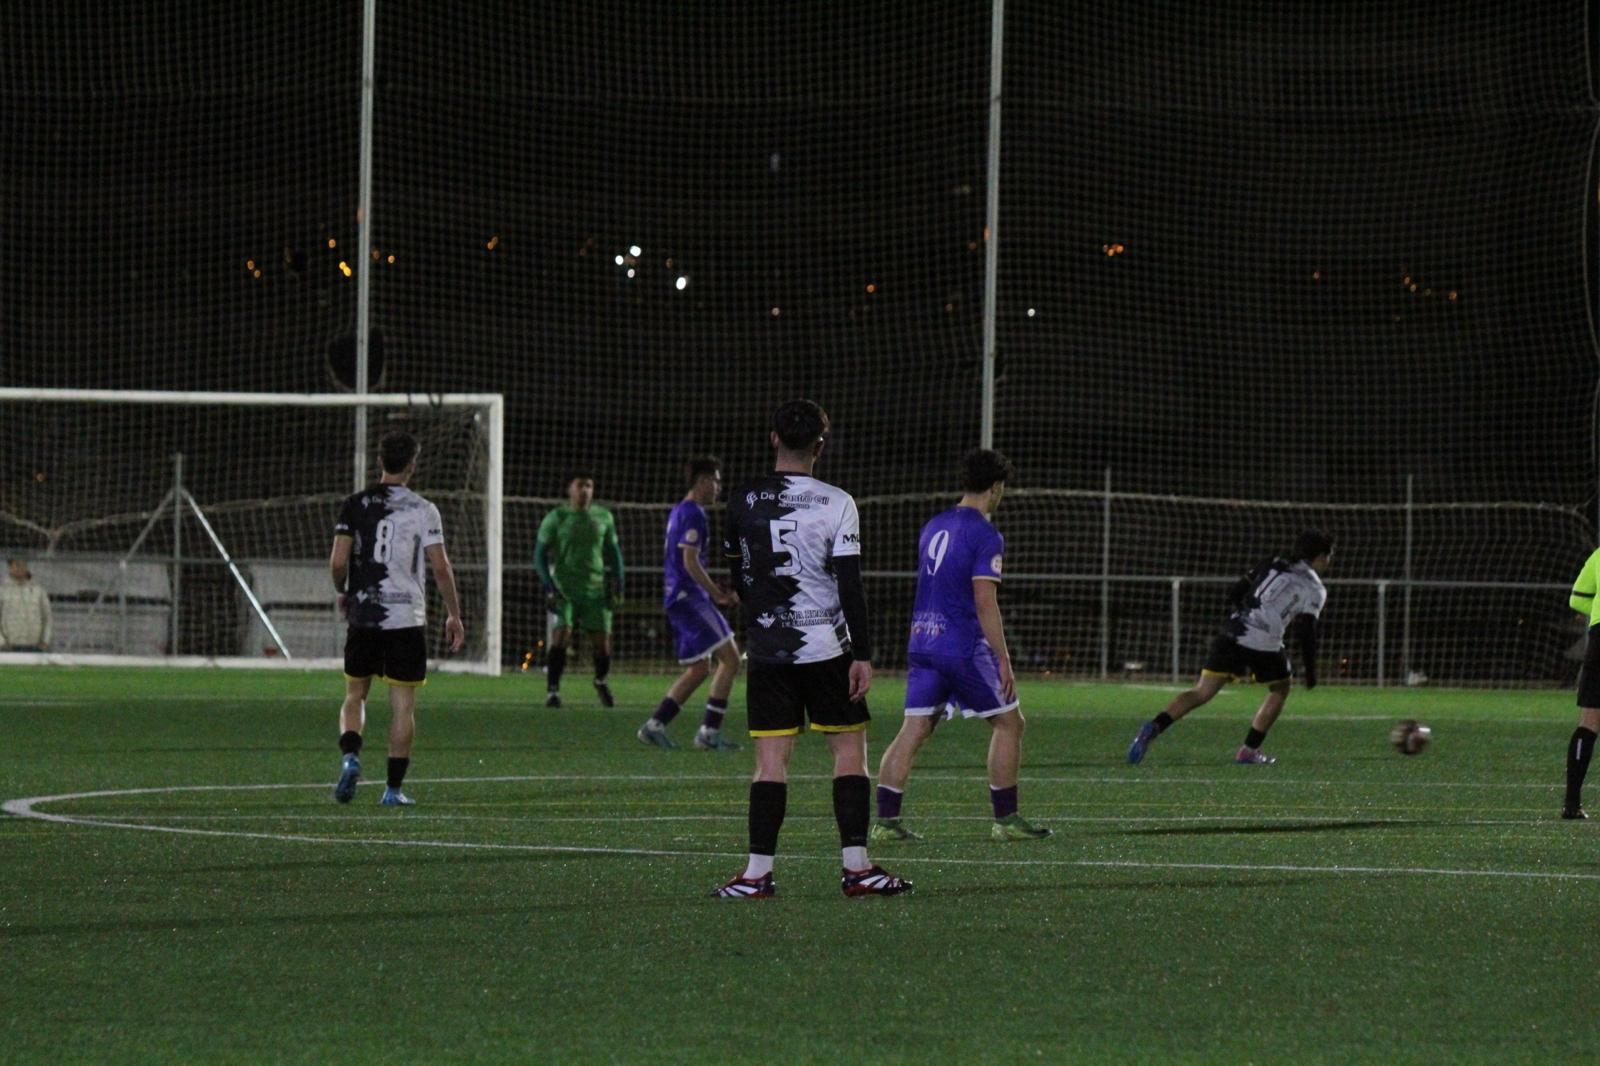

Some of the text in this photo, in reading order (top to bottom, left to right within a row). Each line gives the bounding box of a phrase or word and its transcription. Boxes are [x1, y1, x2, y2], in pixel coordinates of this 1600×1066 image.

[760, 491, 776, 501] De
[373, 519, 395, 564] 8
[769, 519, 803, 577] 5
[926, 529, 950, 577] 9
